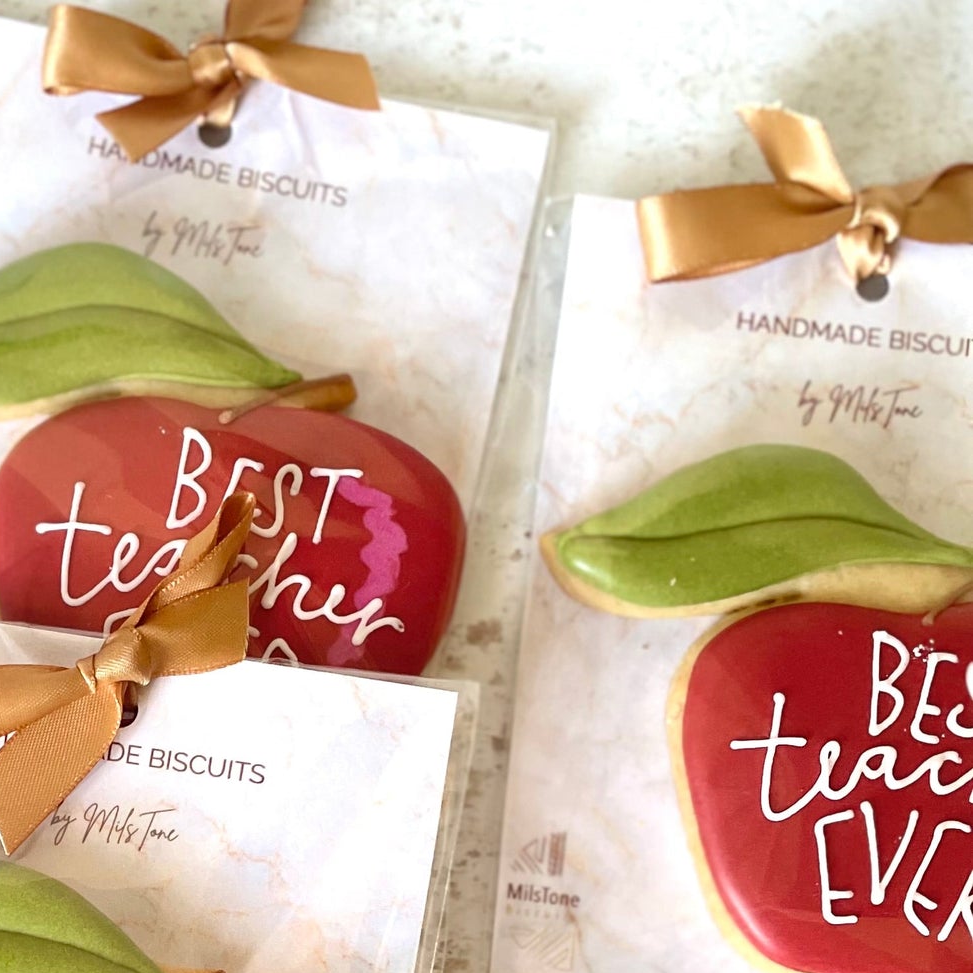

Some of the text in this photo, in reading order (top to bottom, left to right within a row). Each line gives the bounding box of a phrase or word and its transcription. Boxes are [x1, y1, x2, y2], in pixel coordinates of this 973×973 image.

[88, 136, 348, 207] HADMADE BISCUITS
[141, 210, 164, 256] by
[736, 310, 973, 357] HANDMADE BISCUI
[797, 380, 821, 426] by
[148, 747, 267, 785] BISCUITS
[729, 692, 973, 823] teac
[50, 805, 77, 846] by
[507, 882, 581, 908] MilsTone
